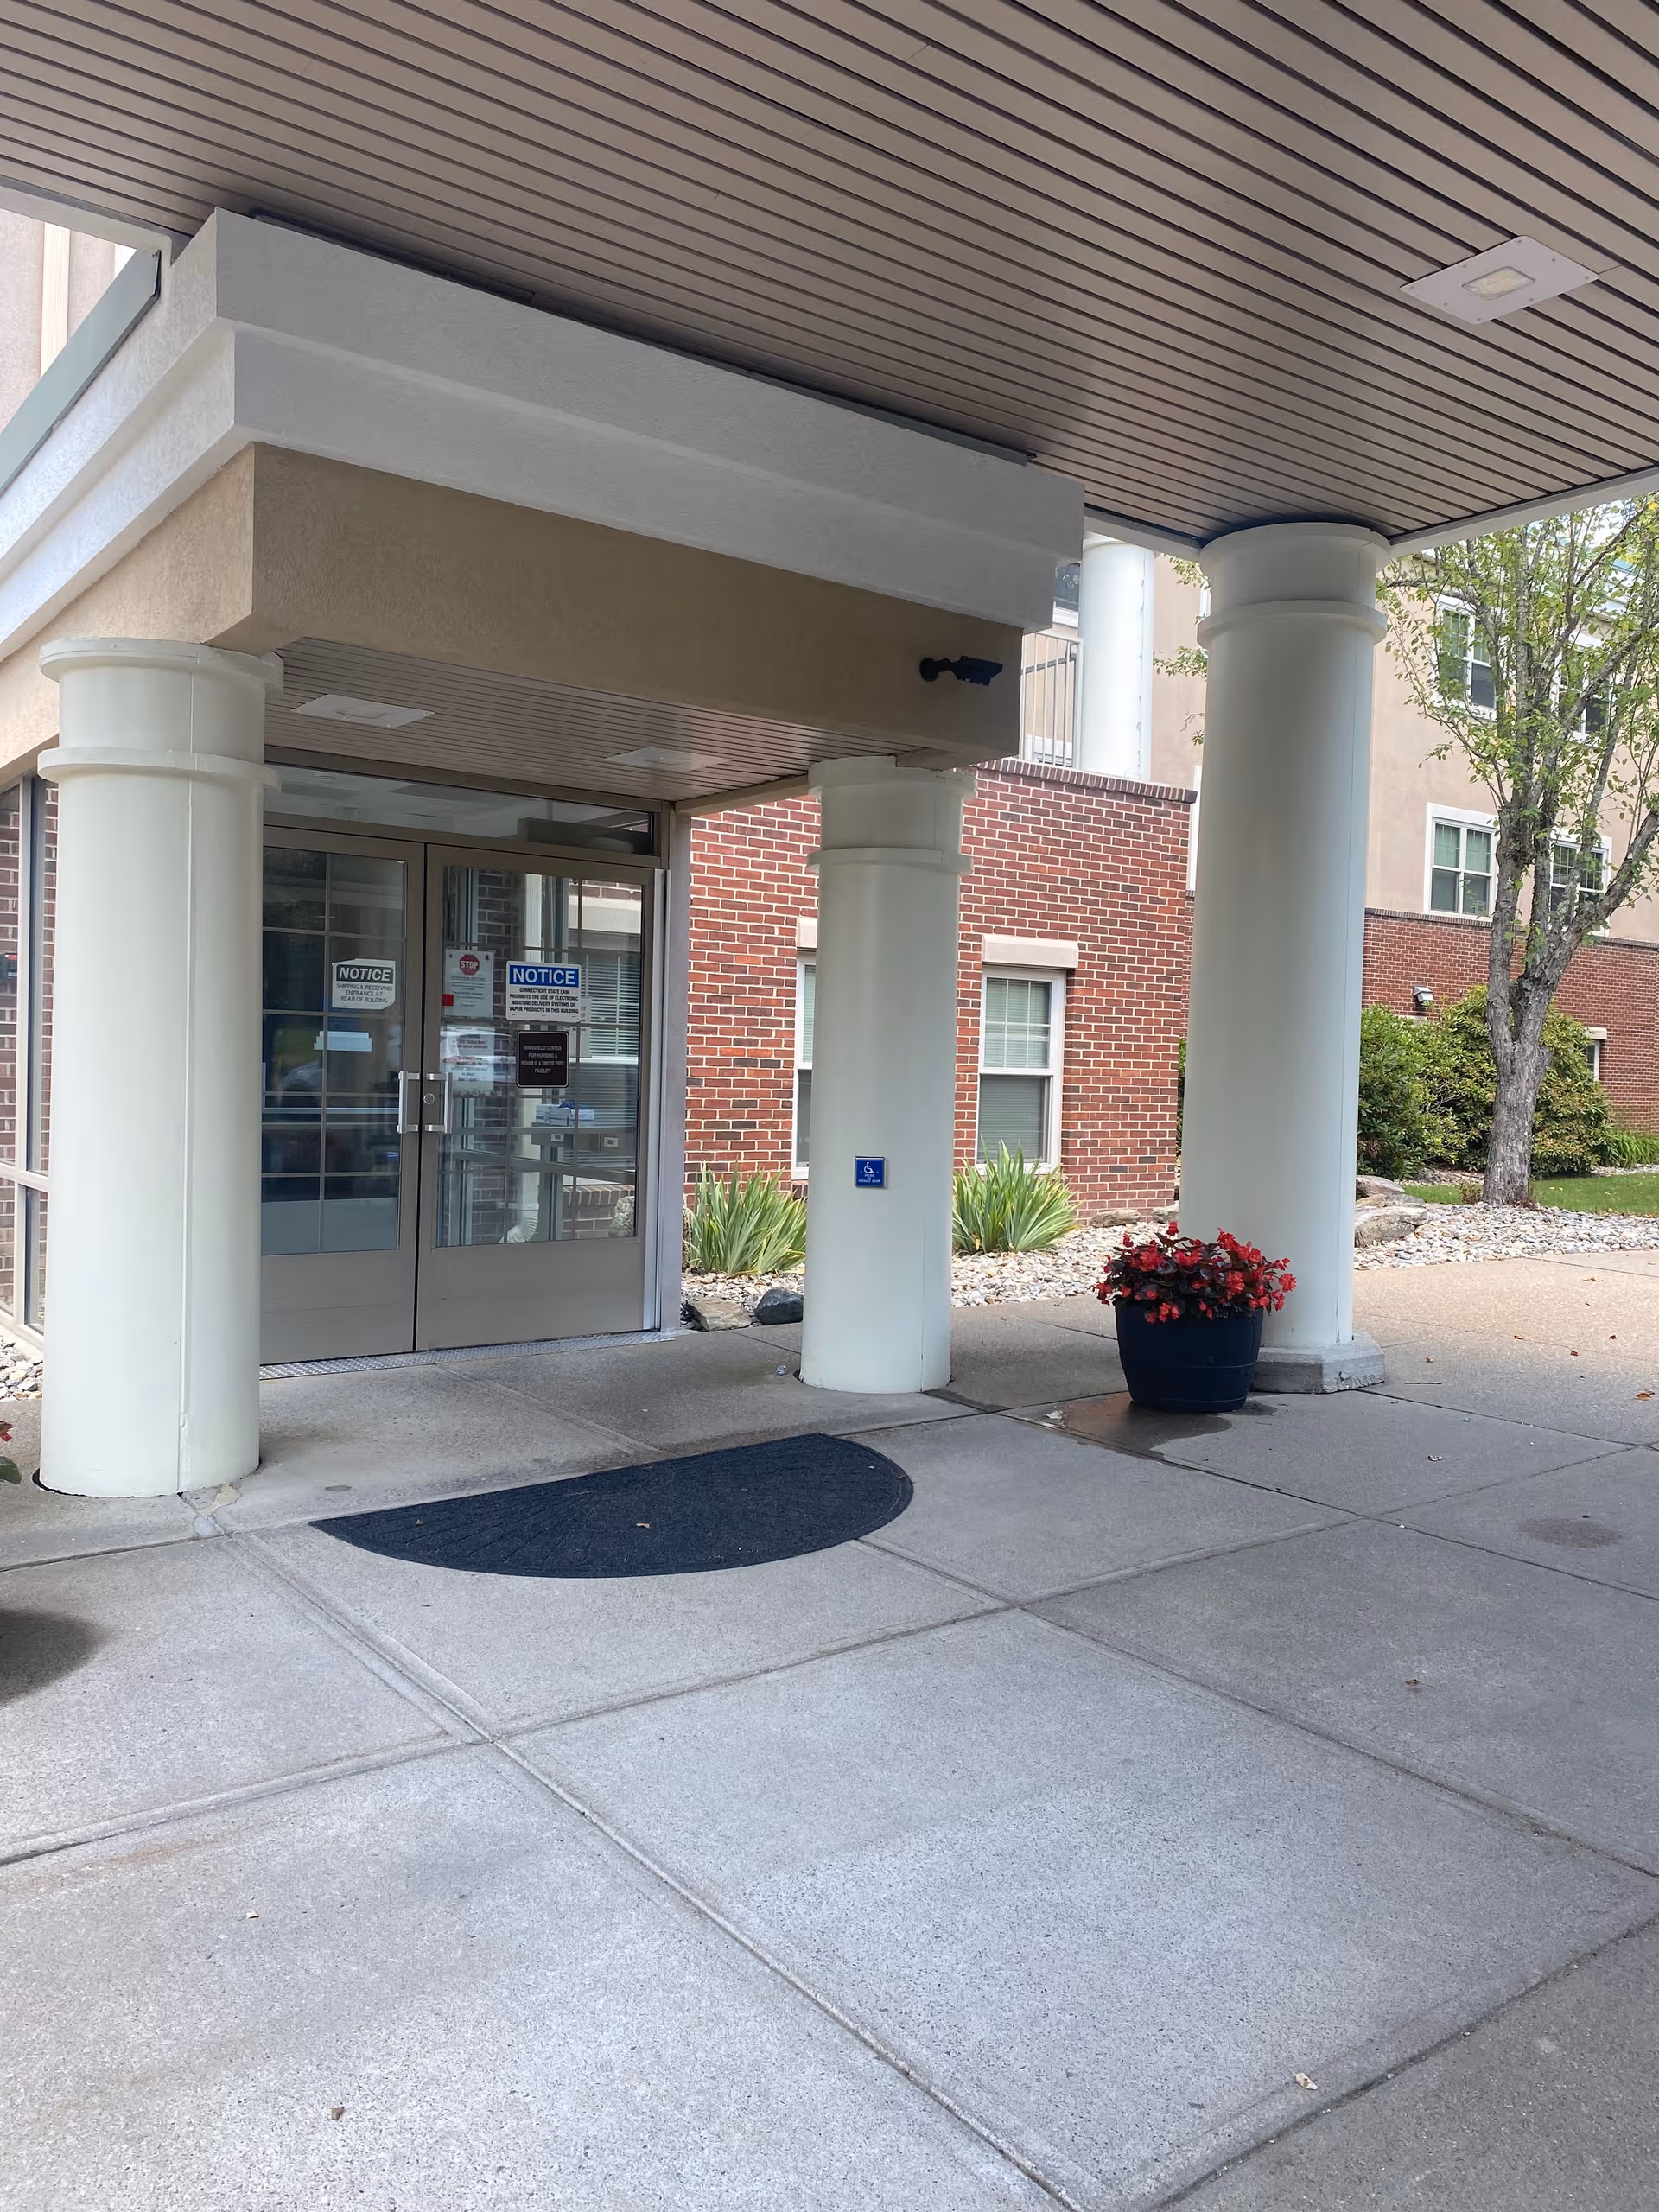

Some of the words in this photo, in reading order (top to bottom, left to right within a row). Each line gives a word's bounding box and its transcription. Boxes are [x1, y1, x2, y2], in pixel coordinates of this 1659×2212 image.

[461, 960, 479, 969] STOP
[339, 967, 391, 982] NOTICE
[512, 968, 575, 985] NOTICE
